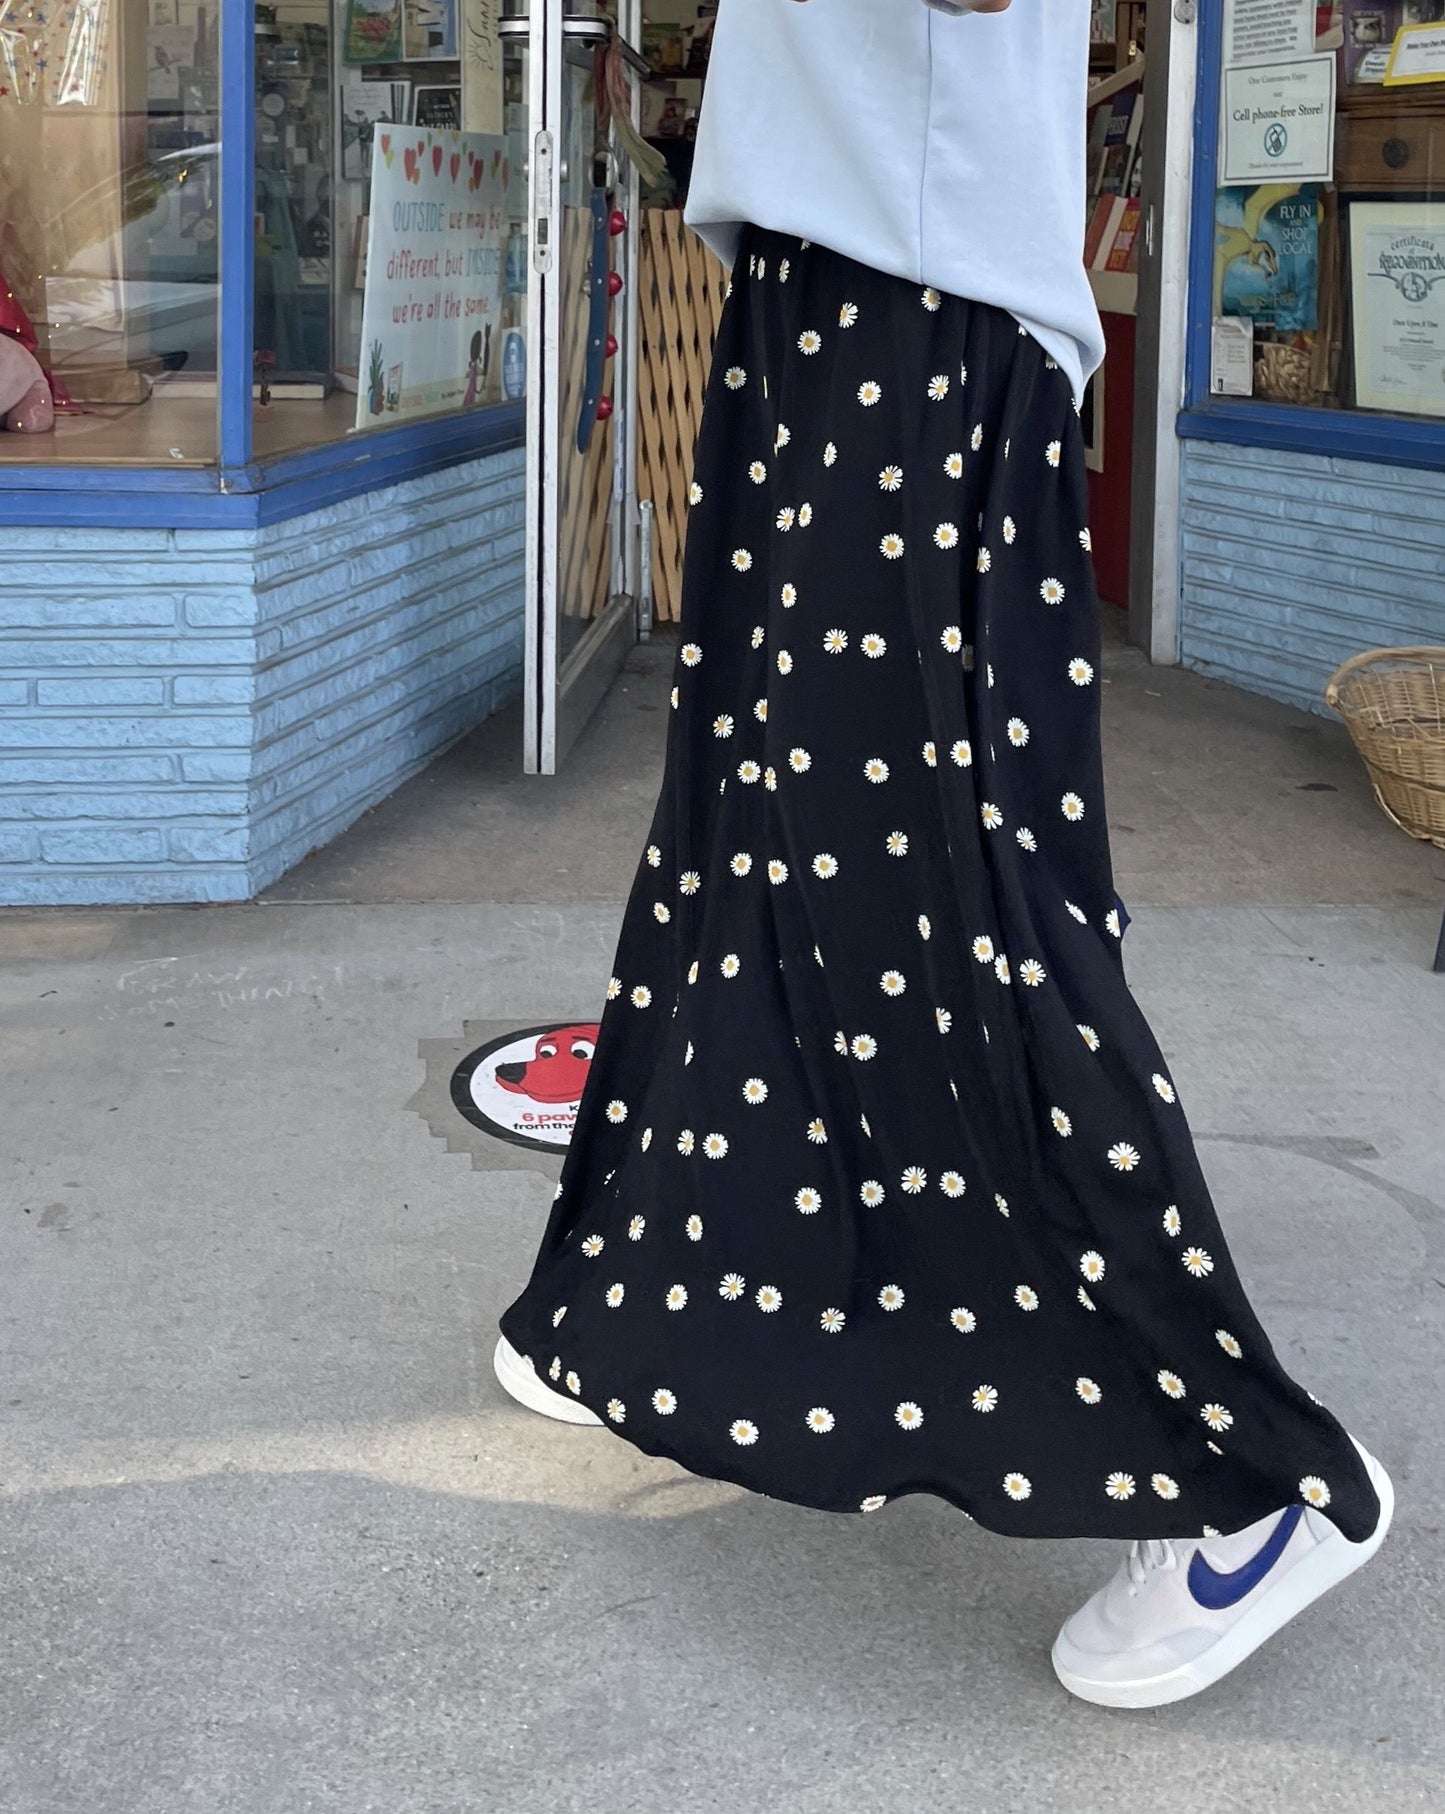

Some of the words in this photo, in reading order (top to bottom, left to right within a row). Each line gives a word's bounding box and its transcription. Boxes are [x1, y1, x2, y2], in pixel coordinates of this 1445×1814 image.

[1233, 108, 1250, 121] Cell
[1252, 104, 1296, 125] phone-free
[1298, 102, 1324, 117] Store!
[1280, 204, 1296, 219] FLY
[1300, 204, 1311, 218] IN
[393, 202, 446, 232] OUTSIDE
[449, 211, 463, 230] we
[466, 211, 487, 240] may
[490, 204, 500, 230] be
[1282, 227, 1308, 241] SHOP
[1279, 242, 1313, 256] LOCAL
[387, 249, 441, 280] different,
[445, 249, 464, 278] but
[467, 248, 500, 277] INSIDE
[392, 294, 424, 324] we're
[427, 292, 442, 320] all
[444, 294, 461, 319] the
[522, 1112, 534, 1122] 6
[513, 1122, 550, 1130] from
